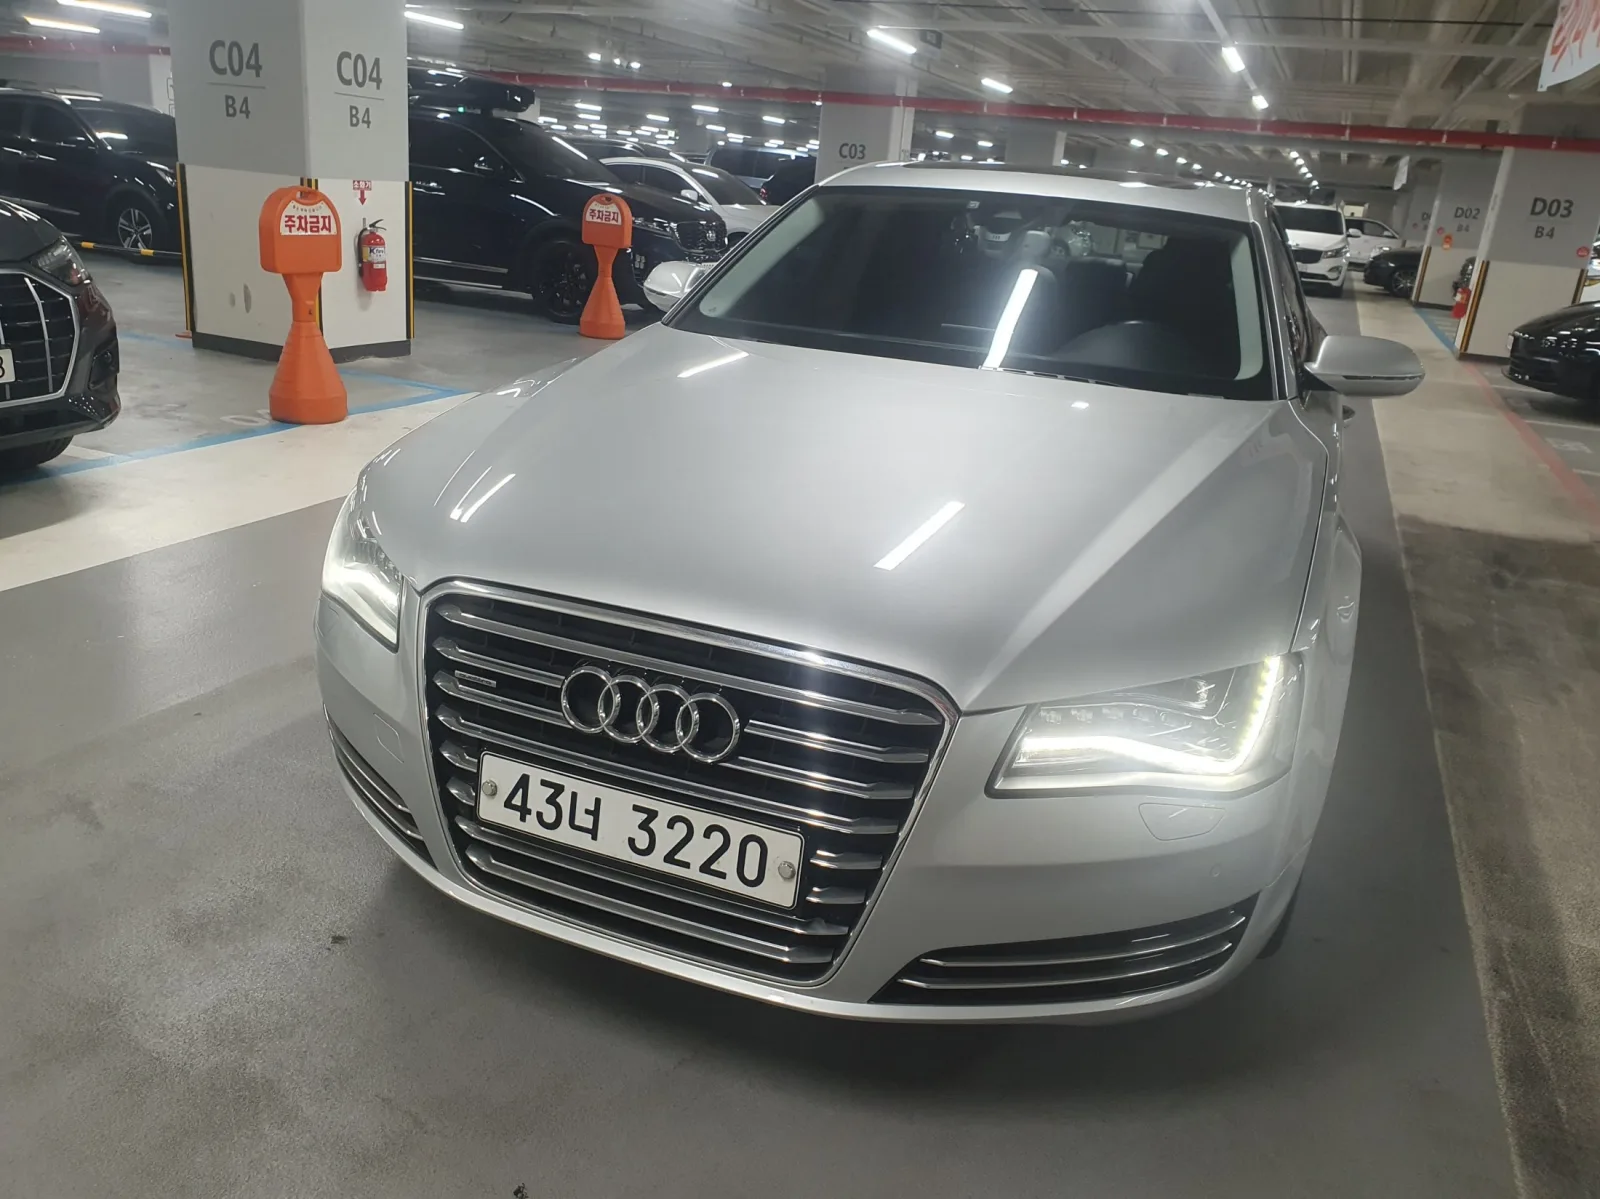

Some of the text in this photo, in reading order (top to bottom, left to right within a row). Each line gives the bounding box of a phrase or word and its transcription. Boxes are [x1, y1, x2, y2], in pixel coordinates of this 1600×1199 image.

[208, 39, 262, 78] C04
[336, 51, 383, 90] C04
[224, 94, 251, 119] B4
[349, 105, 371, 129] B4
[838, 143, 866, 160] C03
[589, 208, 619, 223] 주차금지
[1454, 206, 1480, 219] D02
[1530, 196, 1574, 218] D03
[284, 214, 332, 233] 주차금지
[1534, 225, 1555, 239] B4
[503, 773, 769, 888] 43너 3220
